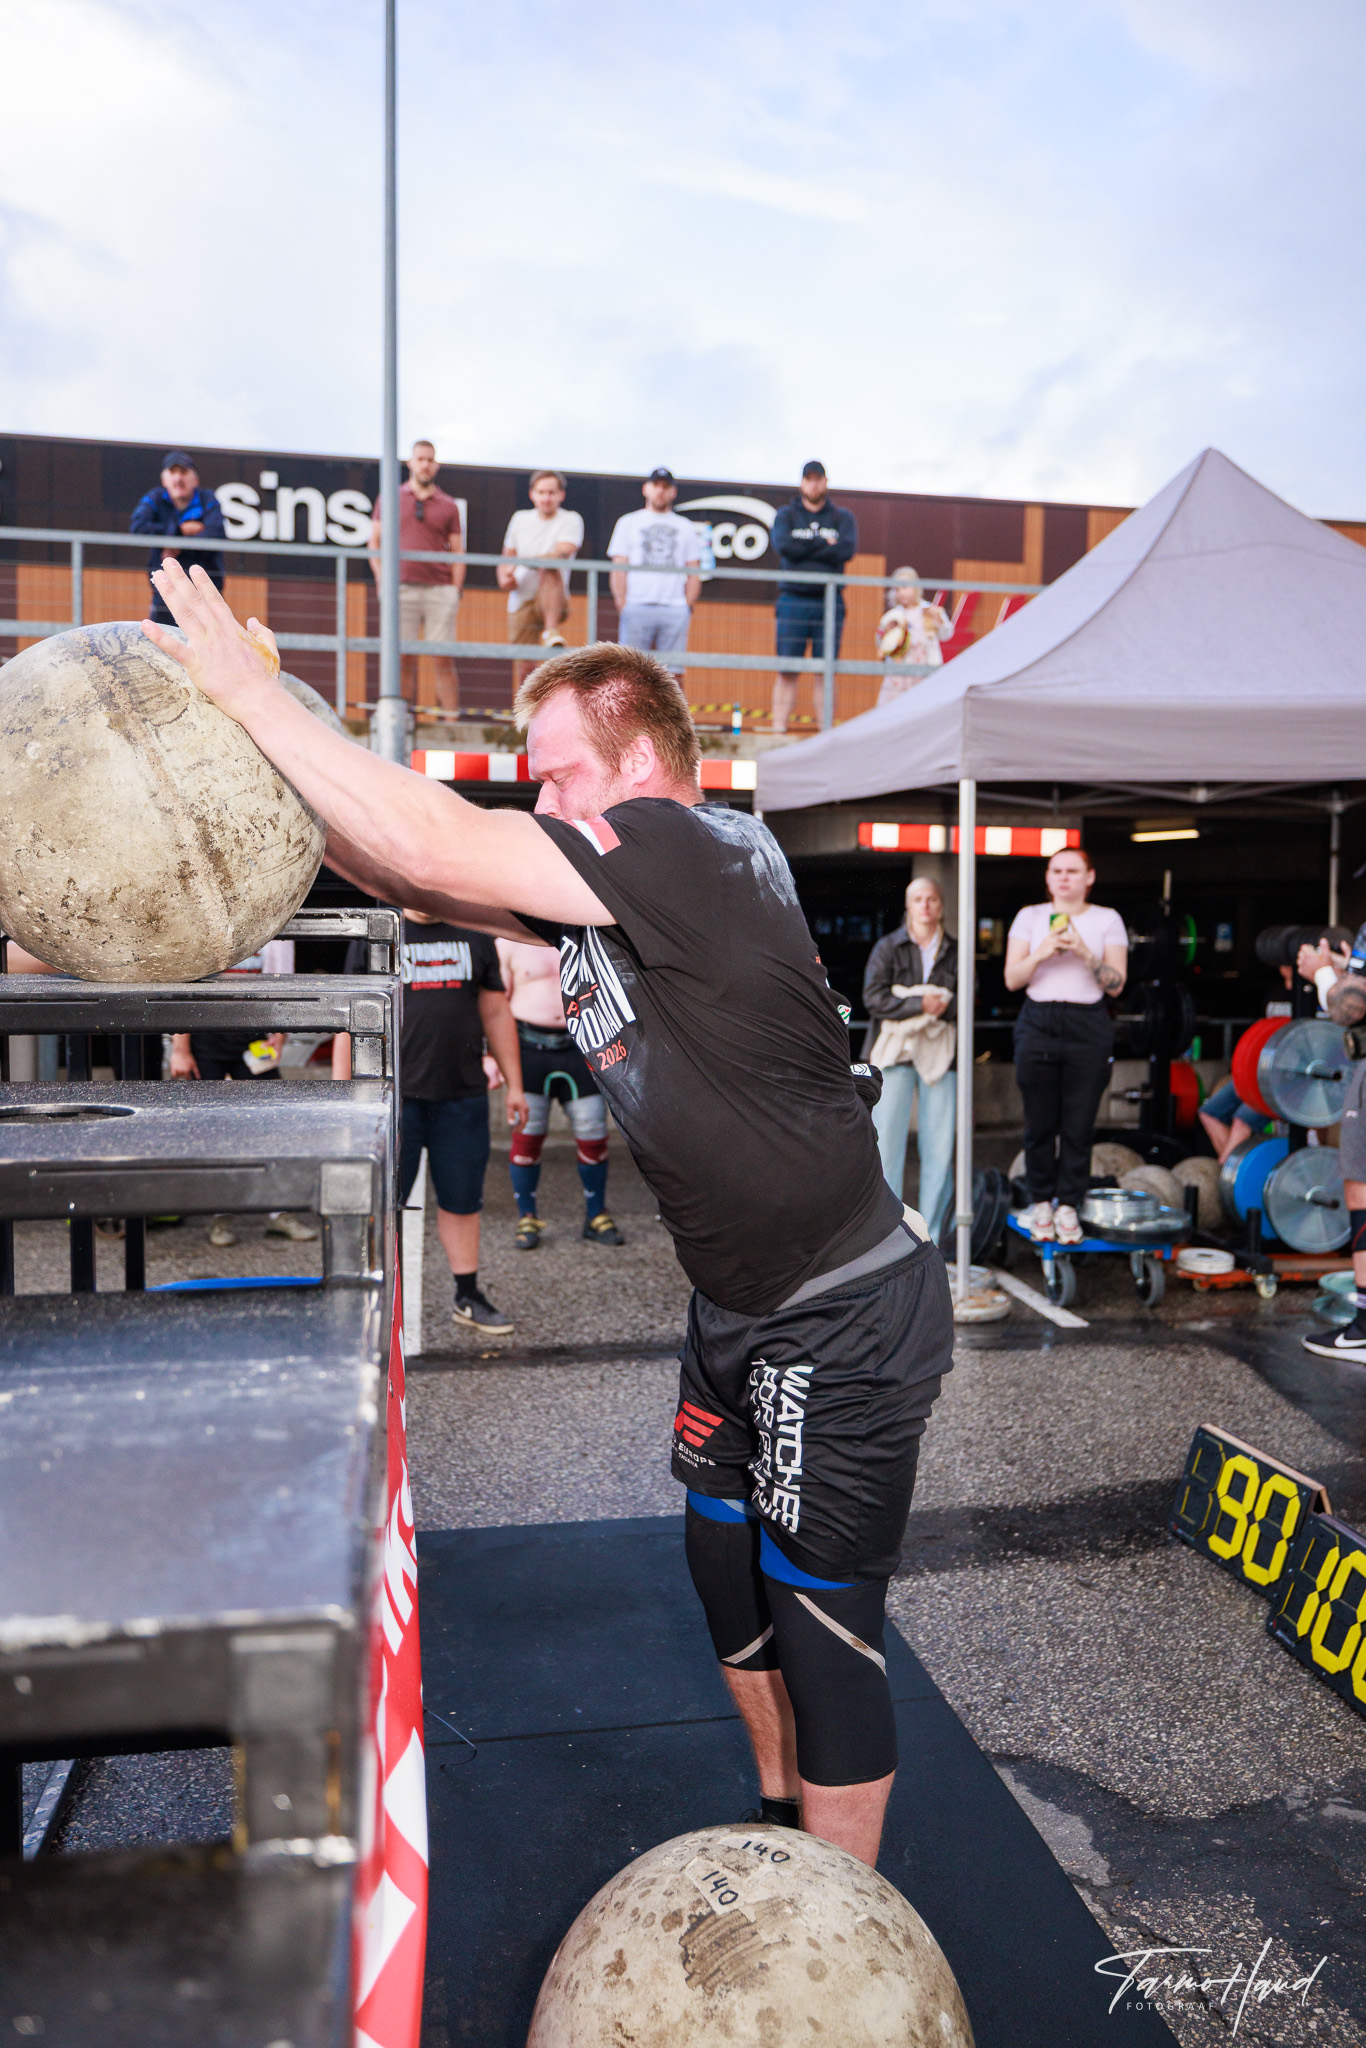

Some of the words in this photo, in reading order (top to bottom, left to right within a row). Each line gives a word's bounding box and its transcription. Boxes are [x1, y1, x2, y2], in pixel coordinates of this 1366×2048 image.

[597, 1039, 628, 1071] 2026
[758, 1366, 779, 1429] FOR
[678, 1443, 717, 1466] EUROPE
[1208, 1454, 1301, 1587] 90
[1297, 1546, 1366, 1704] 10
[742, 1841, 790, 1863] 140
[702, 1871, 739, 1905] 140
